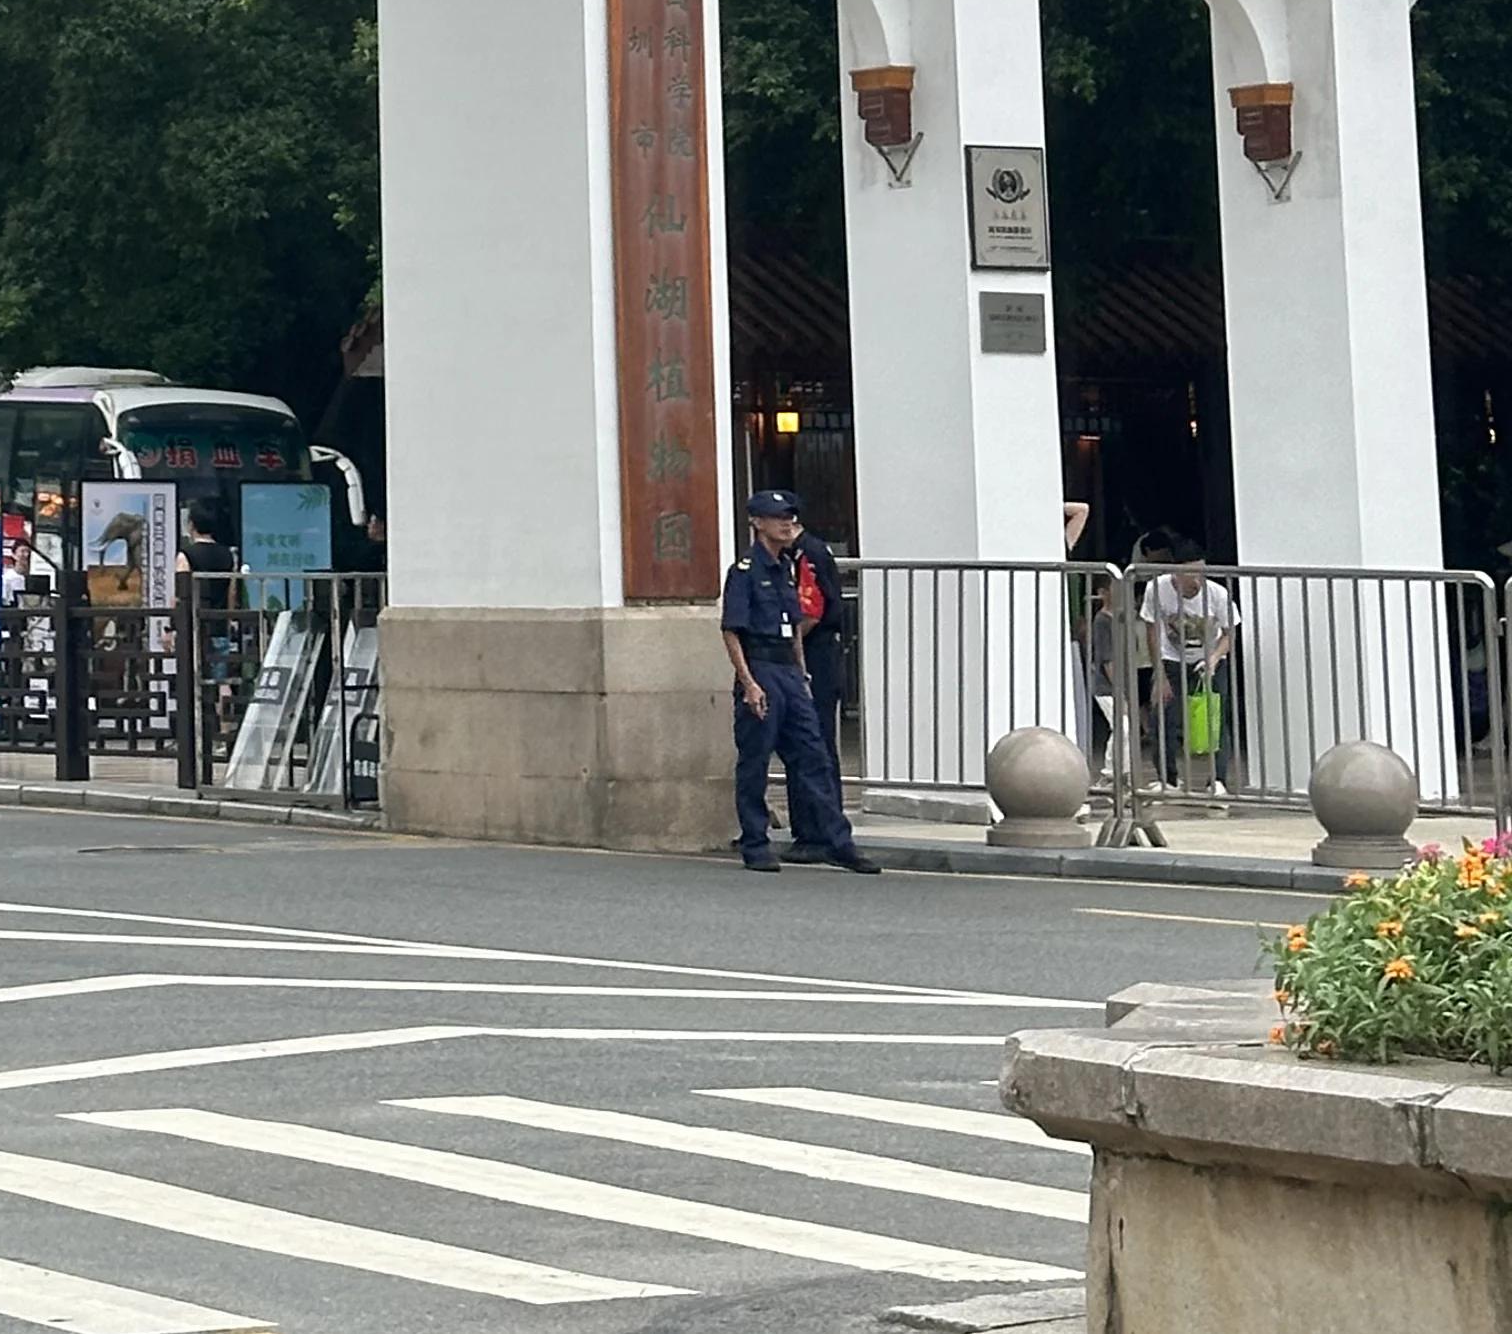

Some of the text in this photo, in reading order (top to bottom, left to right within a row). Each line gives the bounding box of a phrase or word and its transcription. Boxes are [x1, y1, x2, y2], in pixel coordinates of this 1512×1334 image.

[641, 193, 694, 562] 仙湖植物园
